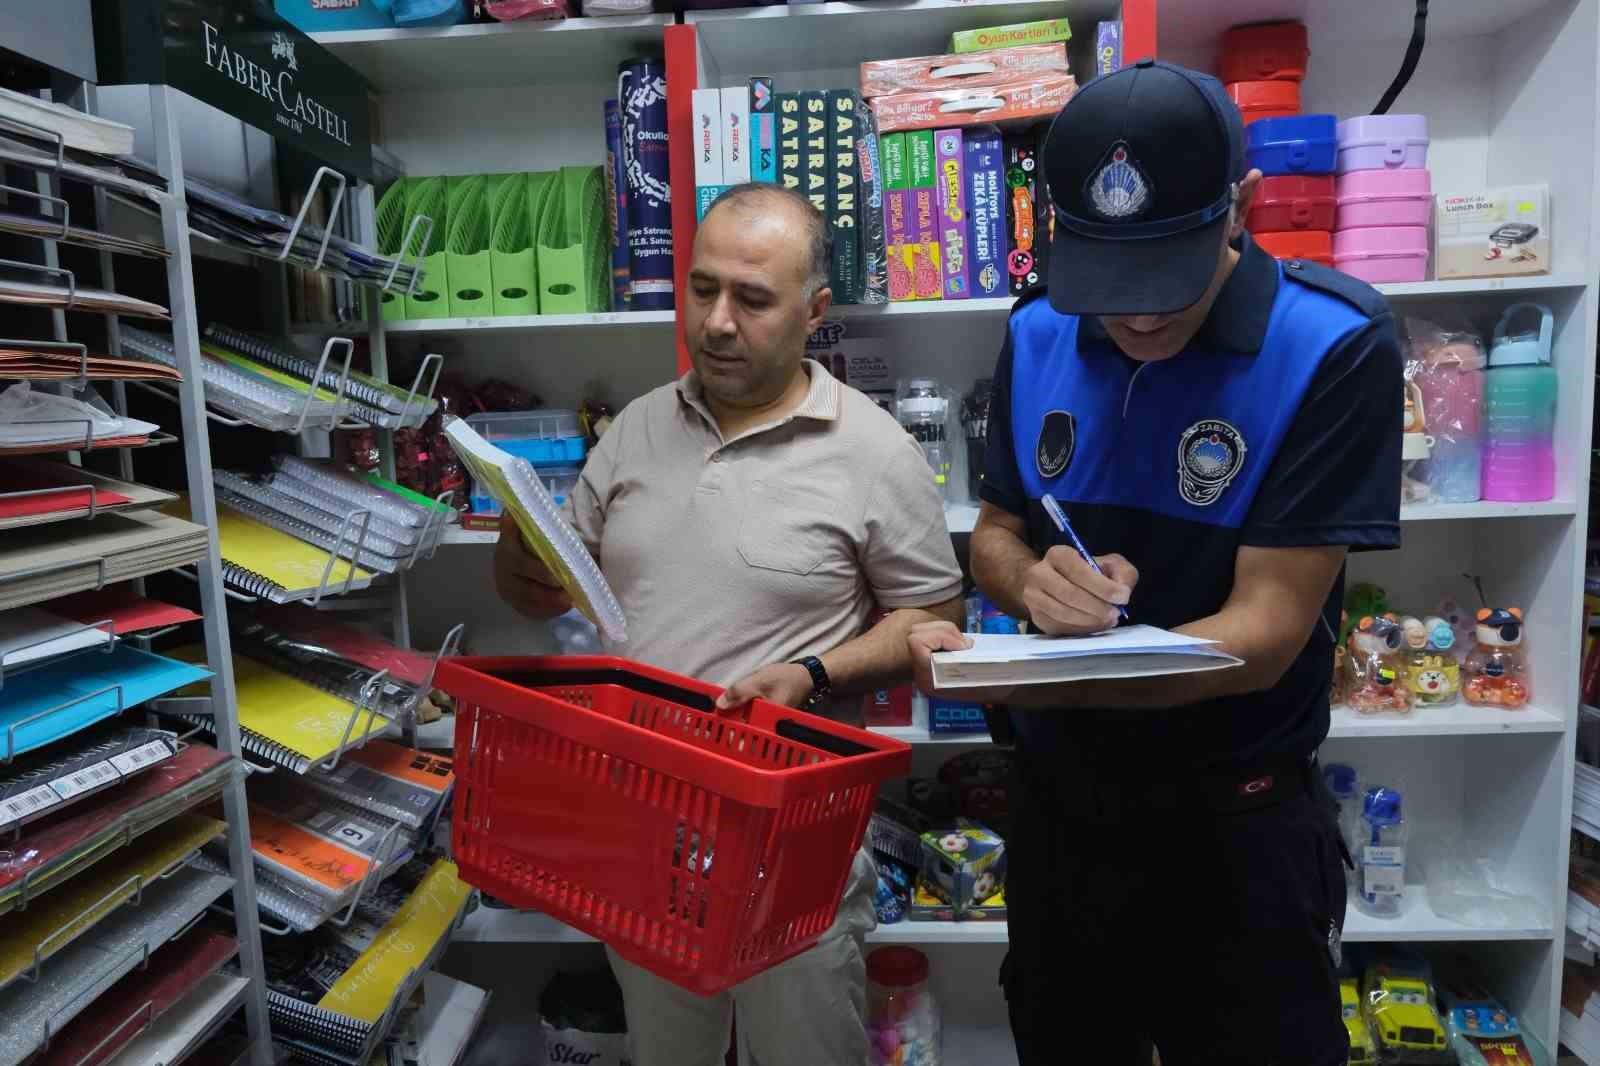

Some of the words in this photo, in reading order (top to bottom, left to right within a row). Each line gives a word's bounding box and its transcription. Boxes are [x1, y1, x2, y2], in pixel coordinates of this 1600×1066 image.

[201, 20, 351, 147] FABER-CASTELL
[731, 128, 739, 162] REDKA
[782, 99, 799, 189] SATRA
[808, 98, 825, 211] SATRAN
[832, 97, 854, 229] SATRANÇ
[1446, 203, 1474, 212] Lunch
[1476, 202, 1493, 210] Box
[550, 1043, 601, 1064] Star
